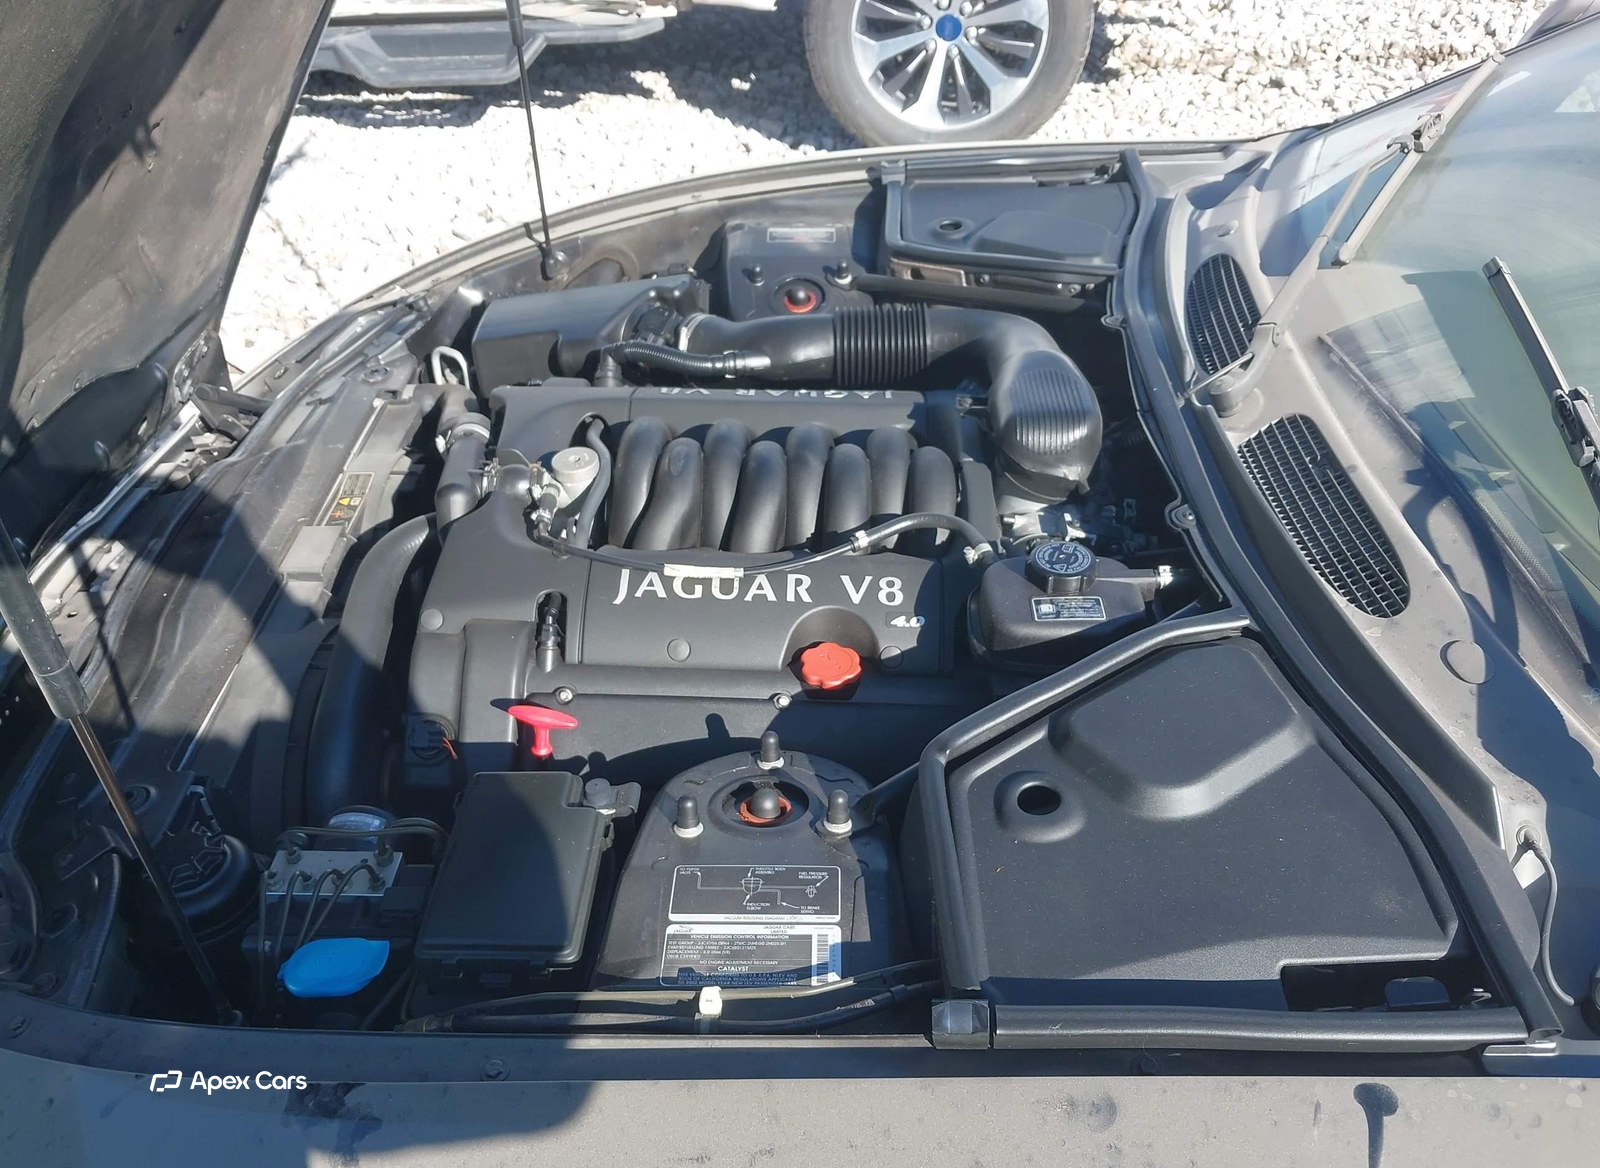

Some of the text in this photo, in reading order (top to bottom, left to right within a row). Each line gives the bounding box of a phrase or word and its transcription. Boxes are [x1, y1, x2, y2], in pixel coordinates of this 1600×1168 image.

[612, 569, 904, 606] JAGUAR V8
[889, 615, 925, 628] 4.0
